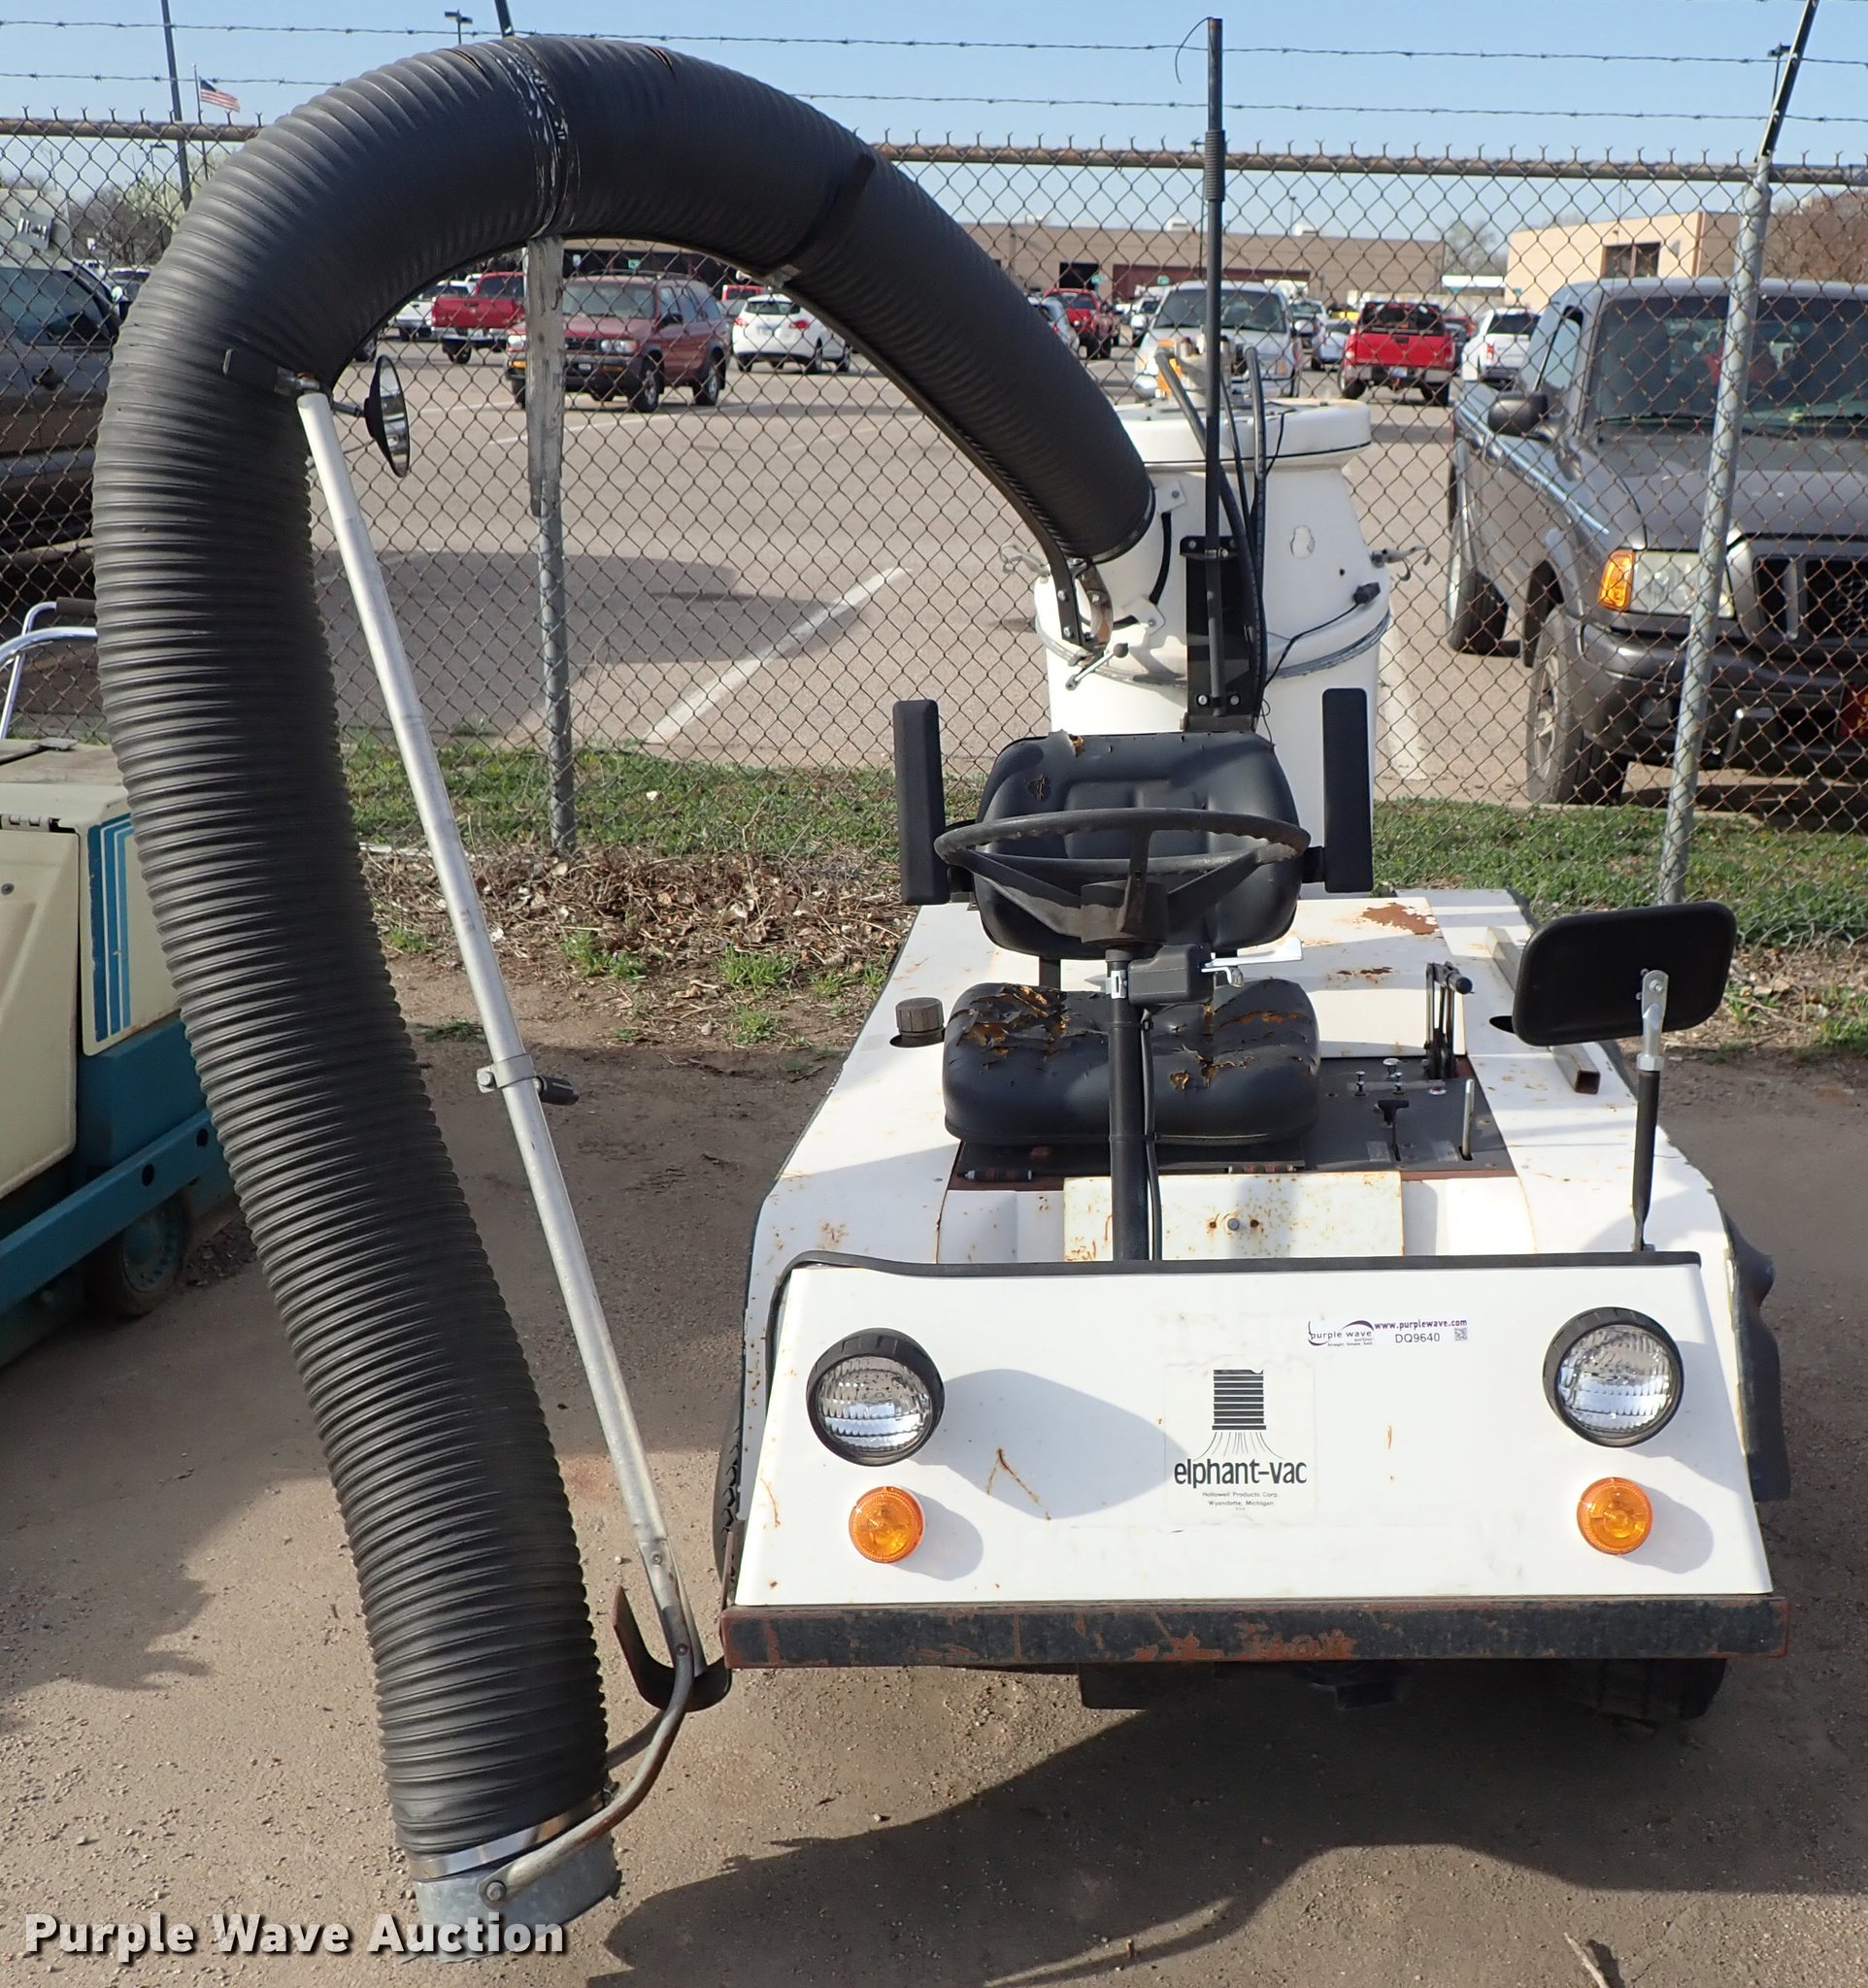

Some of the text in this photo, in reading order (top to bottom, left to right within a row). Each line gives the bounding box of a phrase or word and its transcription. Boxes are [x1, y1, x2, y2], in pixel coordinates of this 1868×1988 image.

[1375, 1319, 1468, 1331] www.purplewave.com
[1311, 1331, 1343, 1340] purple
[1395, 1333, 1441, 1343] DQ9640
[1174, 1458, 1307, 1488] elphant-vac
